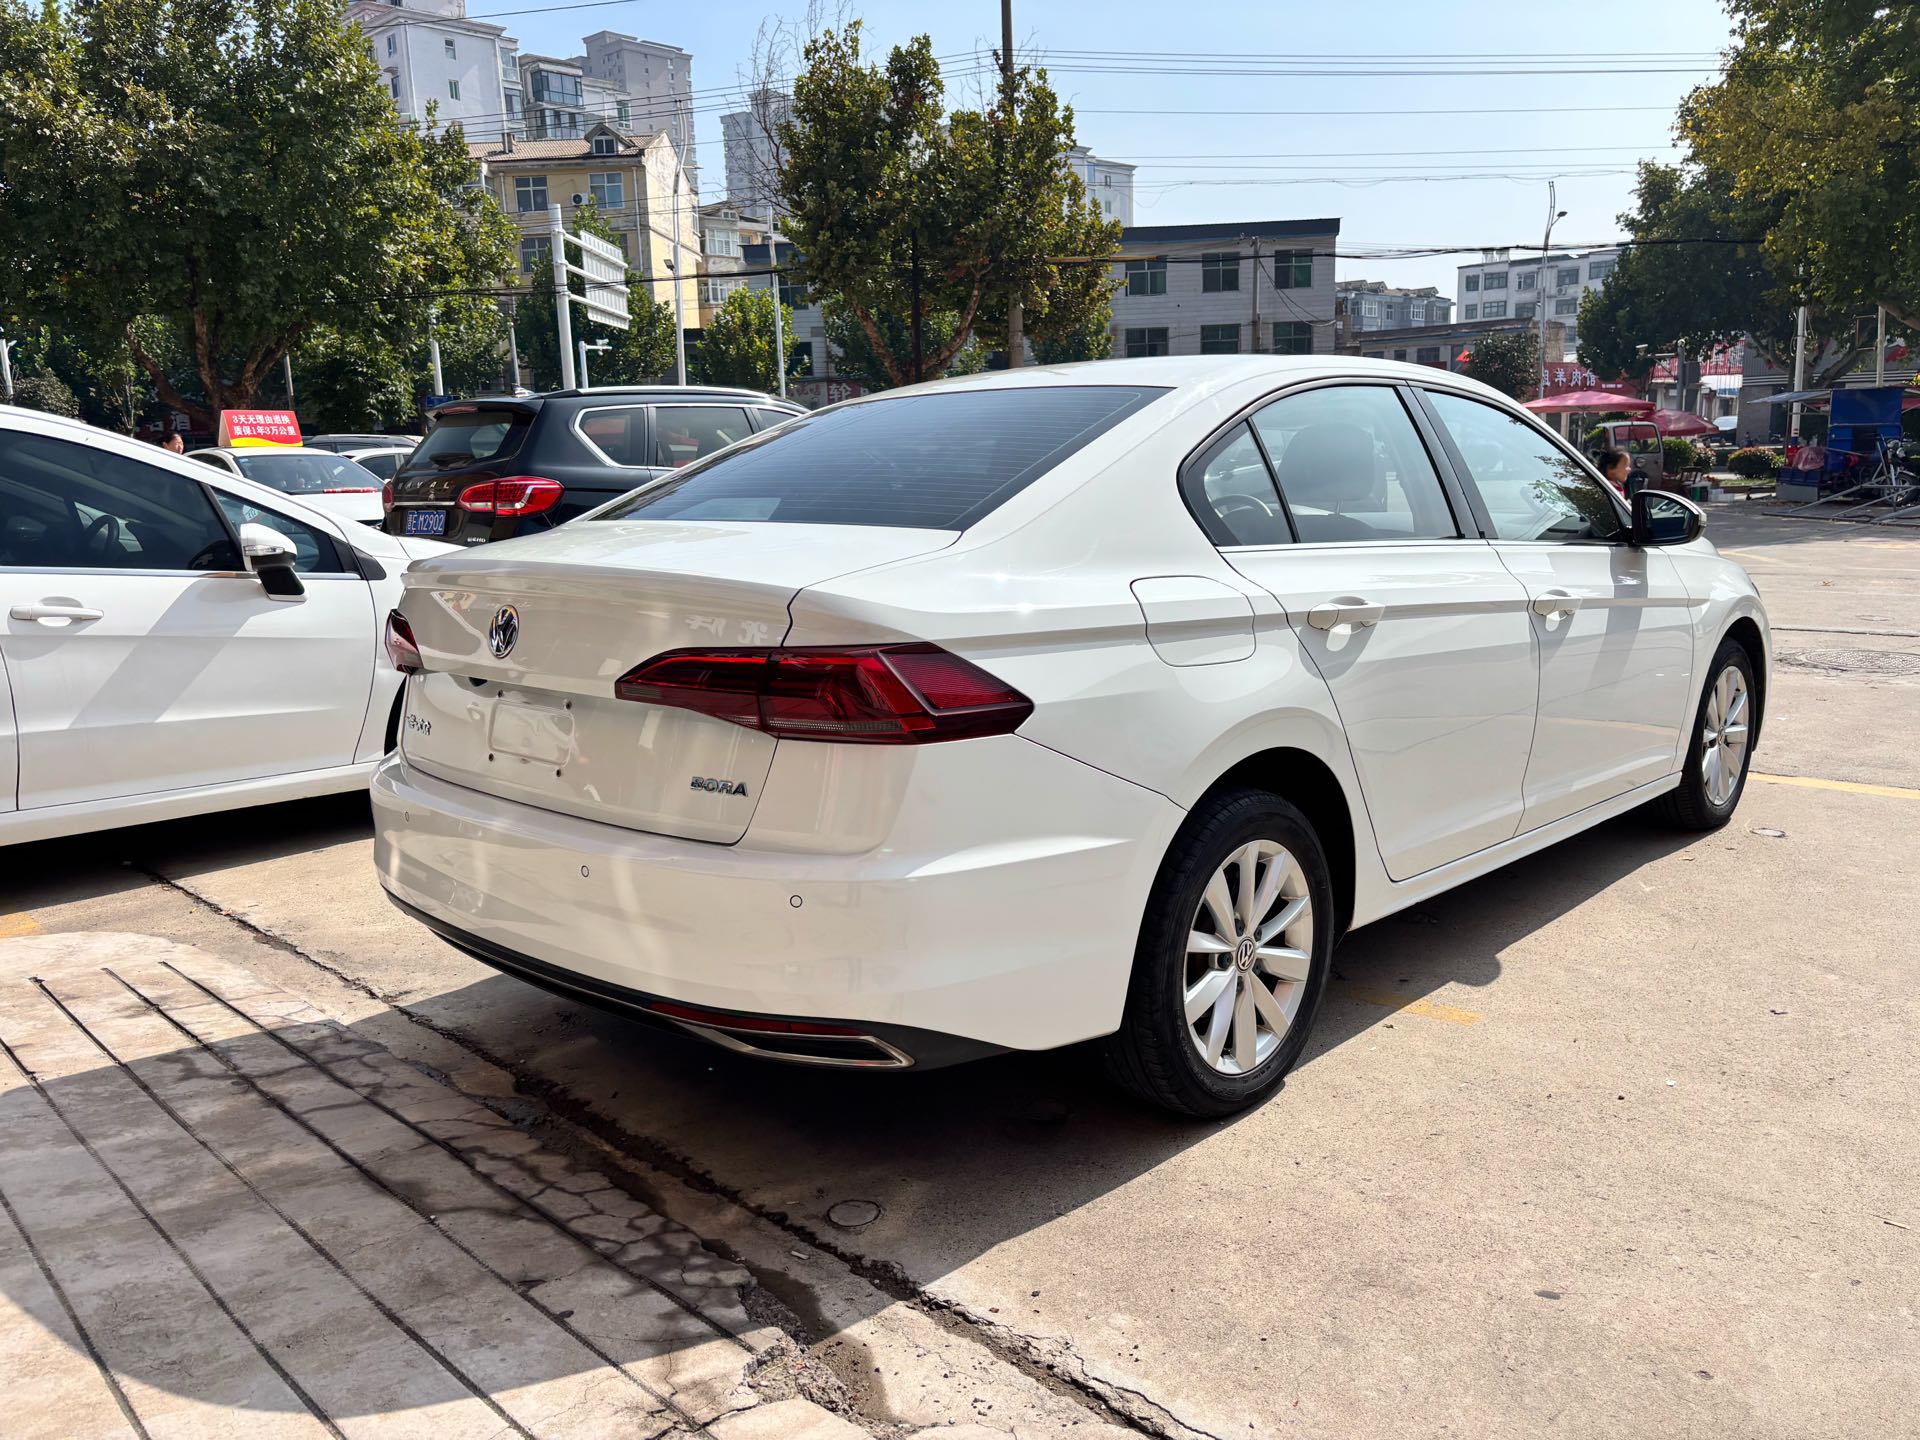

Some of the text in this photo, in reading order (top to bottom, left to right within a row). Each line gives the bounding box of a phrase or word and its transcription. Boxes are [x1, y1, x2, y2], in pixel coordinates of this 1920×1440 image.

[232, 414, 291, 425] 3天无理由退换
[233, 425, 297, 436] 质保1年3万公里
[398, 481, 450, 490] HAVAL
[690, 776, 748, 797] BORA
